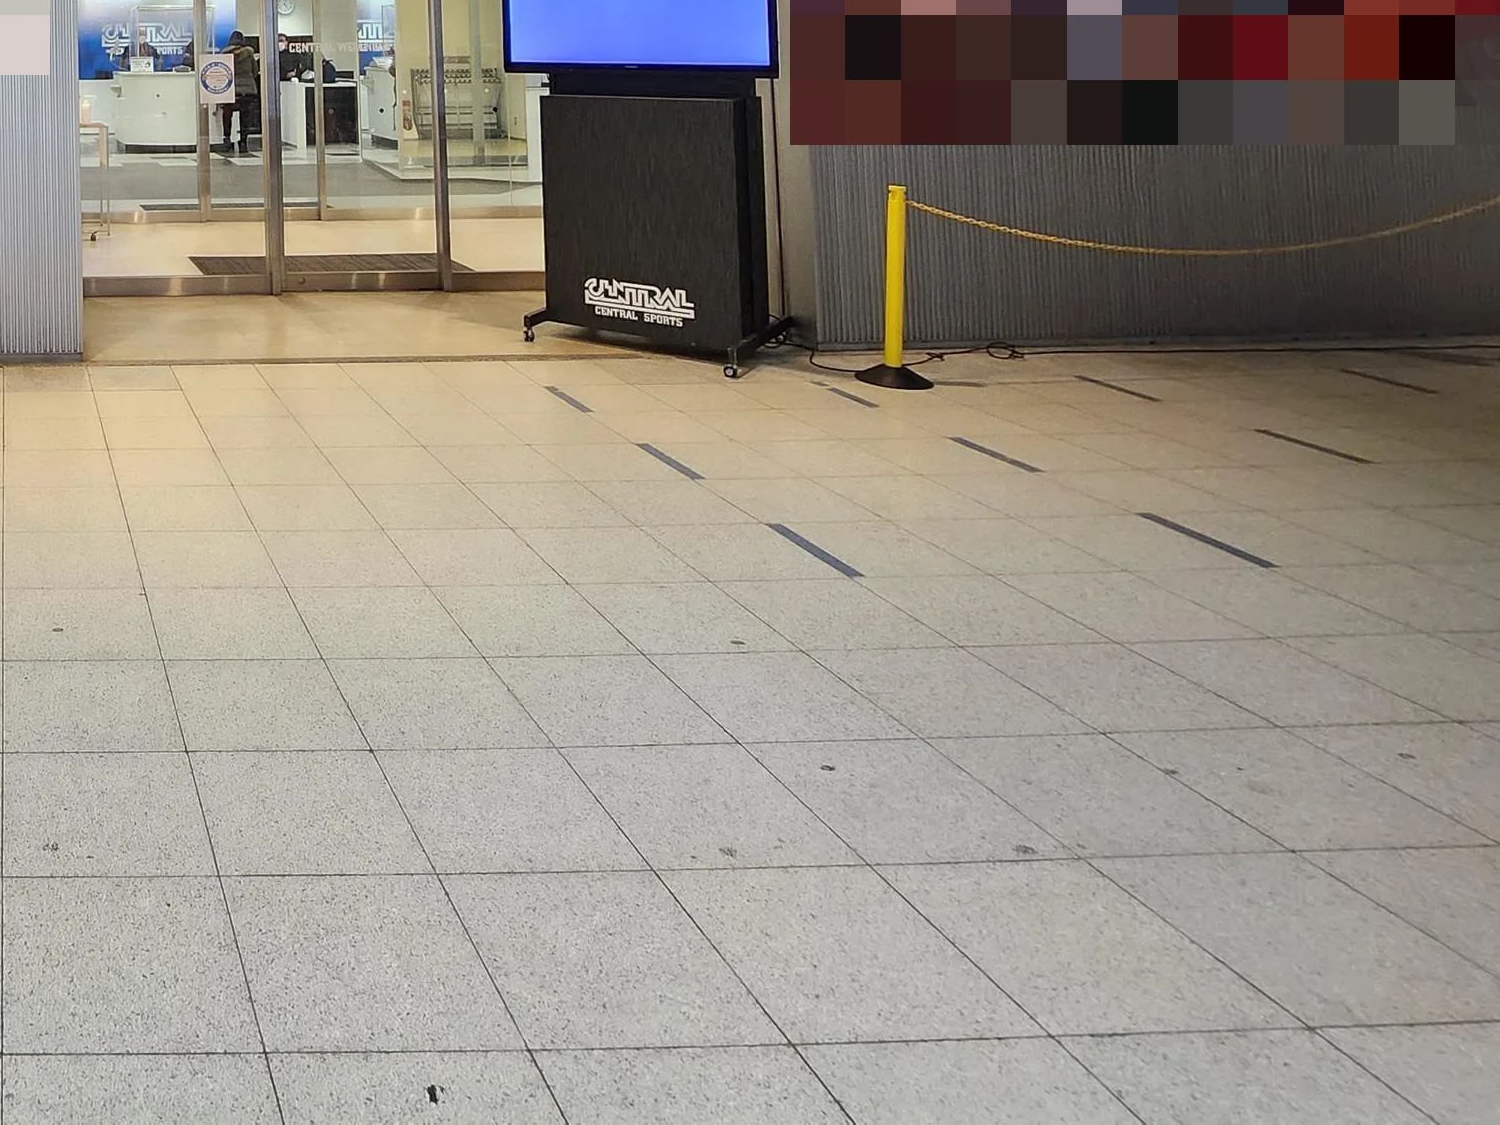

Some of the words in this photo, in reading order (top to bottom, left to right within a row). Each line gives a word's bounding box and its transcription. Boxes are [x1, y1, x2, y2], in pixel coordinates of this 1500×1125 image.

[154, 46, 184, 55] PORTS
[595, 305, 638, 321] CENTRAL
[643, 313, 683, 328] SPORTS
